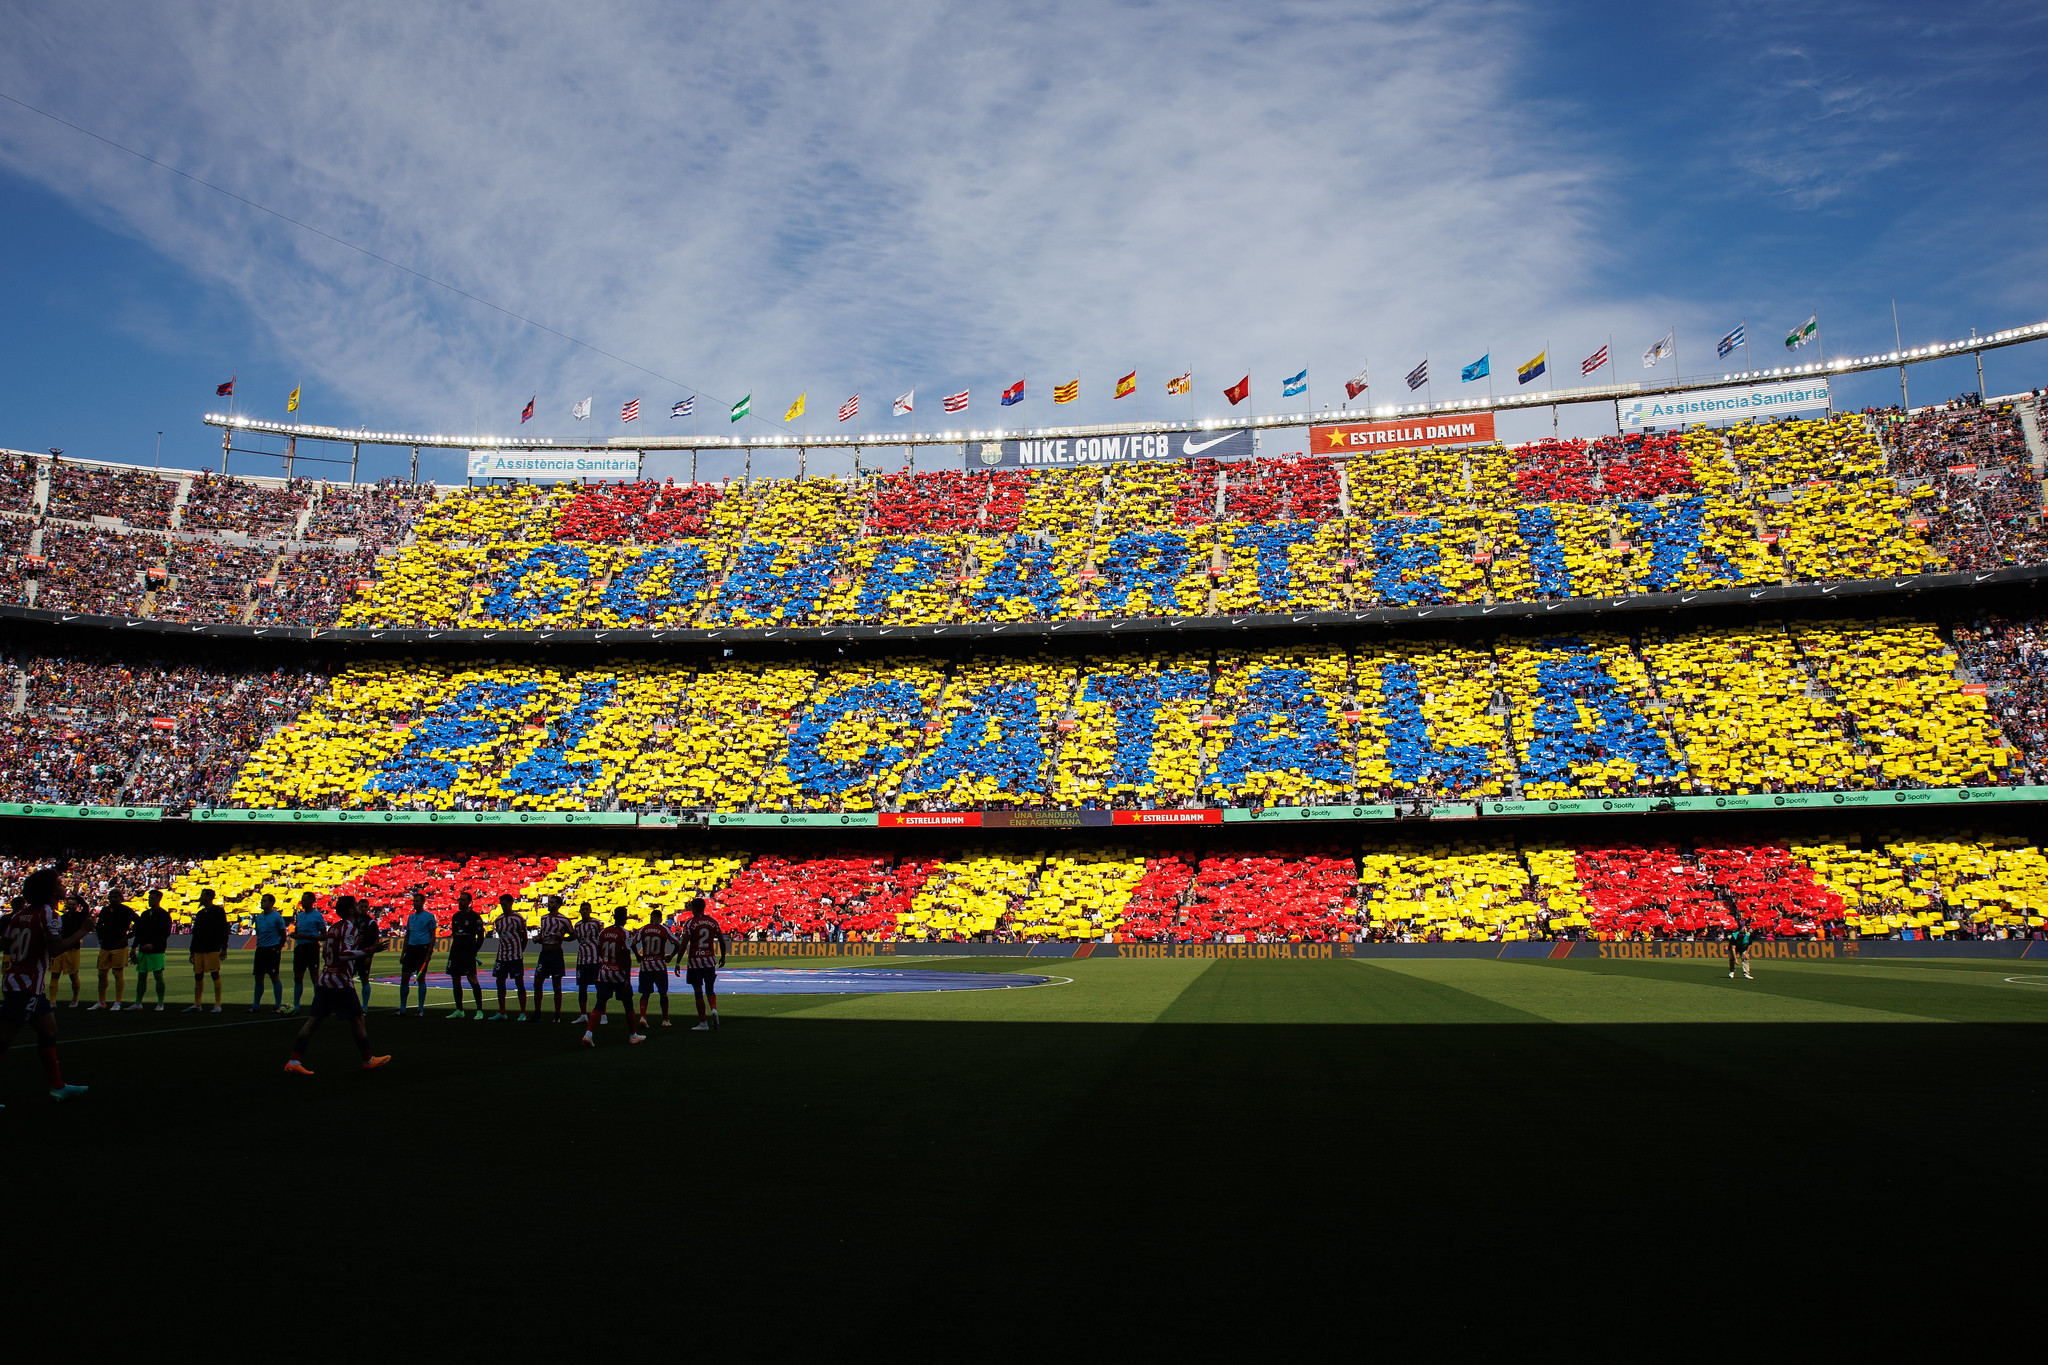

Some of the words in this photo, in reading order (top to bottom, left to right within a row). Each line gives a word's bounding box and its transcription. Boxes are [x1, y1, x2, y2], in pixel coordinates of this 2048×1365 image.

[1652, 397, 1748, 416] Assistència
[1750, 387, 1828, 407] Sanitària
[1350, 427, 1423, 446] ESTRELLA
[1426, 423, 1475, 440] DAMM
[1019, 435, 1169, 464] NIKE.COM/FCB
[495, 458, 574, 470] Assistència
[576, 458, 637, 470] Sanitària
[1845, 794, 1869, 803] Spotify
[1907, 792, 1931, 801] Spotify
[1971, 790, 1996, 799] Spotify
[1613, 800, 1635, 809] Spotify
[1728, 798, 1749, 806] Spotify
[1785, 797, 1808, 805] Spotify
[1504, 804, 1525, 812] Spotify
[1559, 802, 1581, 811] Spotify
[34, 807, 56, 815] Spotify
[90, 808, 111, 817] Spotify
[136, 810, 156, 818] Spotify
[1035, 811, 1079, 819] BANDERA
[1311, 809, 1332, 817] Spotify
[1363, 808, 1384, 816] Spotify
[257, 812, 275, 820] Spotify
[302, 812, 321, 820] Spotify
[348, 813, 366, 821] Spotify
[393, 813, 412, 821] Spotify
[438, 813, 457, 822] Spotify
[484, 815, 502, 823] Spotify
[529, 815, 547, 823] Spotify
[575, 815, 593, 823] Spotify
[728, 816, 746, 824] Spotify
[789, 816, 808, 824] Spotify
[850, 816, 869, 824] Spotify
[1143, 814, 1179, 822] ESTRELLA
[906, 817, 941, 825] ESTRELLA
[698, 927, 710, 949] 2
[10, 928, 32, 962] 20
[644, 935, 662, 955] 10
[603, 941, 617, 963] 11
[712, 942, 875, 957] .FCBARCELONA.COM
[1118, 944, 1332, 959] STORE.FCBARCELONA.COM
[1599, 942, 1835, 959] STORE.FCBARCONA.COM
